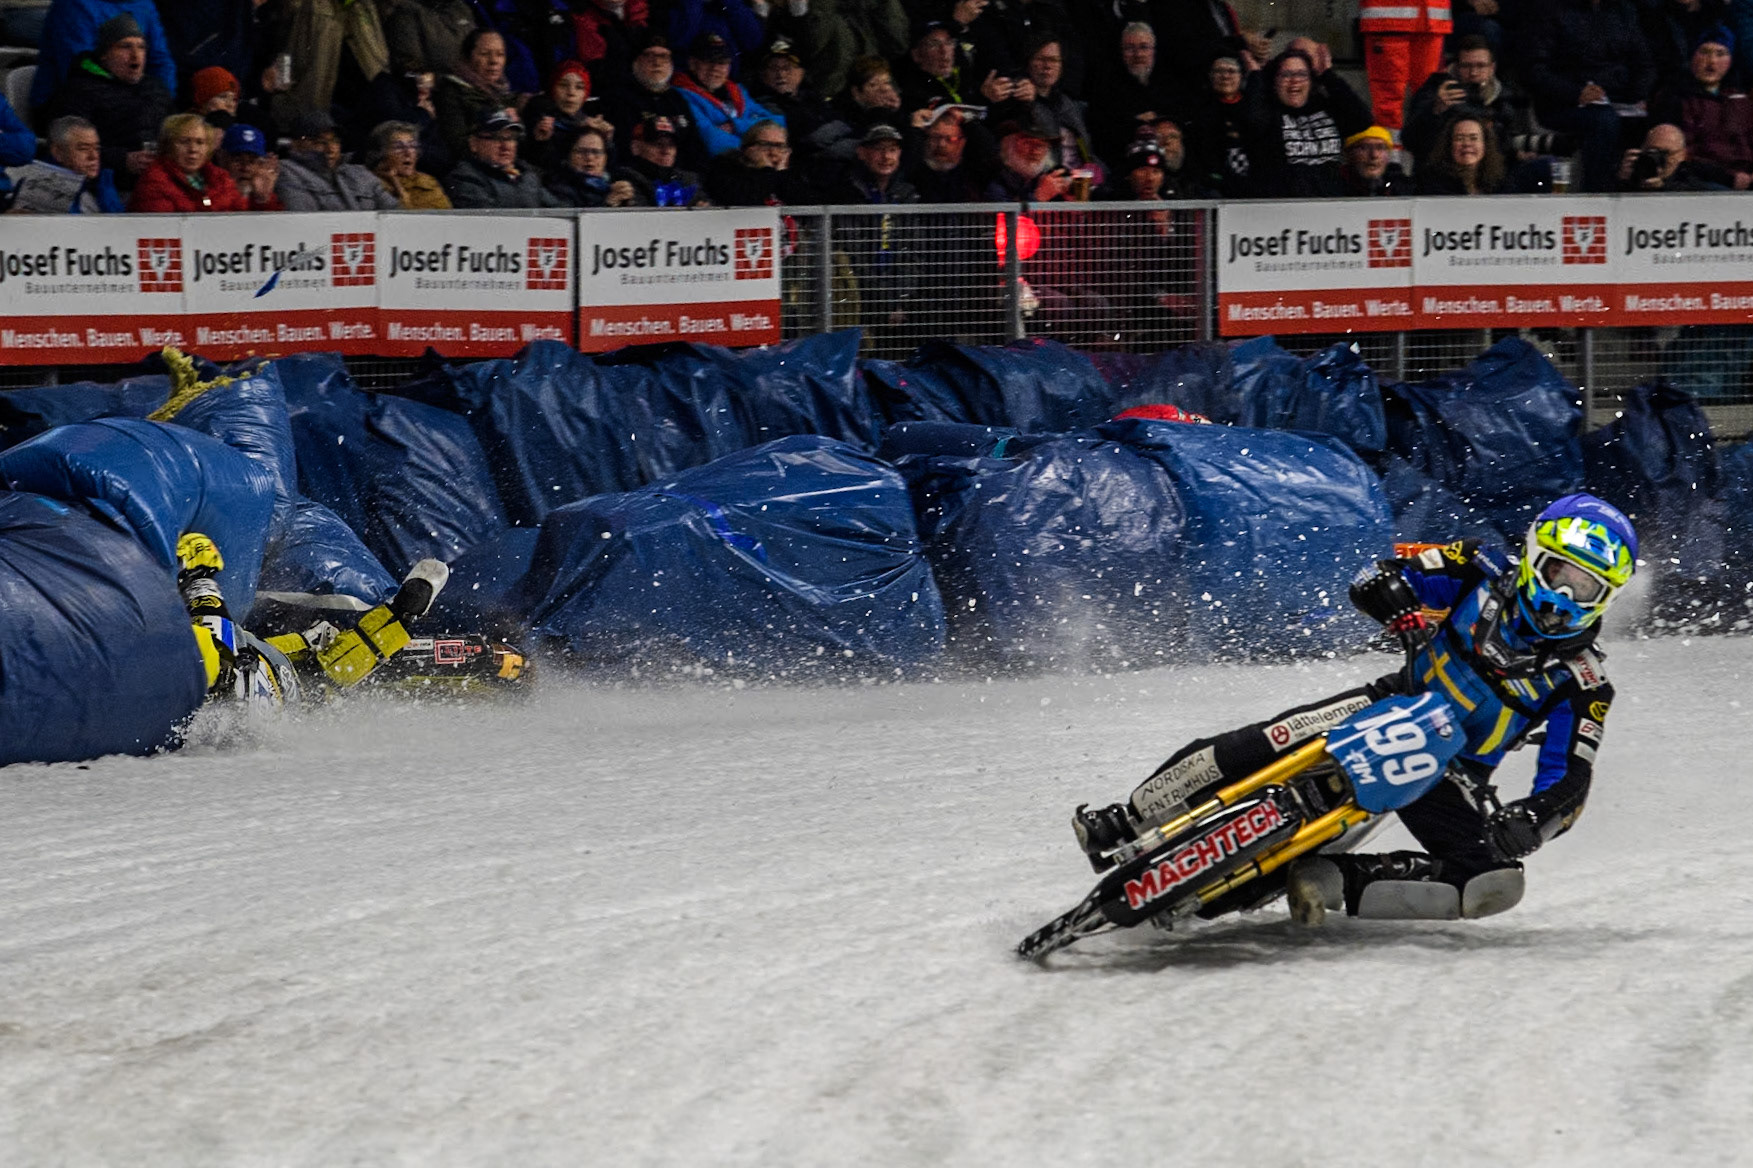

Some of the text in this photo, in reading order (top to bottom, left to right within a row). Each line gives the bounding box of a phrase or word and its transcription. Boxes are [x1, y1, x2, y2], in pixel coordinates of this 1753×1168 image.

[1228, 227, 1362, 263] Josef Fuchs
[1423, 223, 1556, 257] Josef Fuchs
[1625, 222, 1690, 255] Josef
[0, 246, 132, 283] Josef Fuchs
[193, 242, 326, 281] Josef Fuchs
[388, 243, 522, 278] Josef Fuchs
[592, 238, 729, 275] Josef Fuchs
[1227, 299, 1414, 321] Menschen. Bauen. Werte.
[1422, 295, 1606, 314] Menschen. Bauen. Werte.
[1624, 293, 1709, 312] Menschen.
[1, 327, 83, 348] Menschen.
[86, 328, 138, 347] Bauen.
[196, 321, 376, 345] Menschen. Bauen. Werte.
[387, 322, 567, 342] Menschen. Bauen. Werte.
[589, 313, 774, 336] Menschen. Bauen. Werte.
[1286, 698, 1370, 732] lättelement
[1353, 706, 1438, 786] 199
[1124, 800, 1289, 911] MACHTECH
